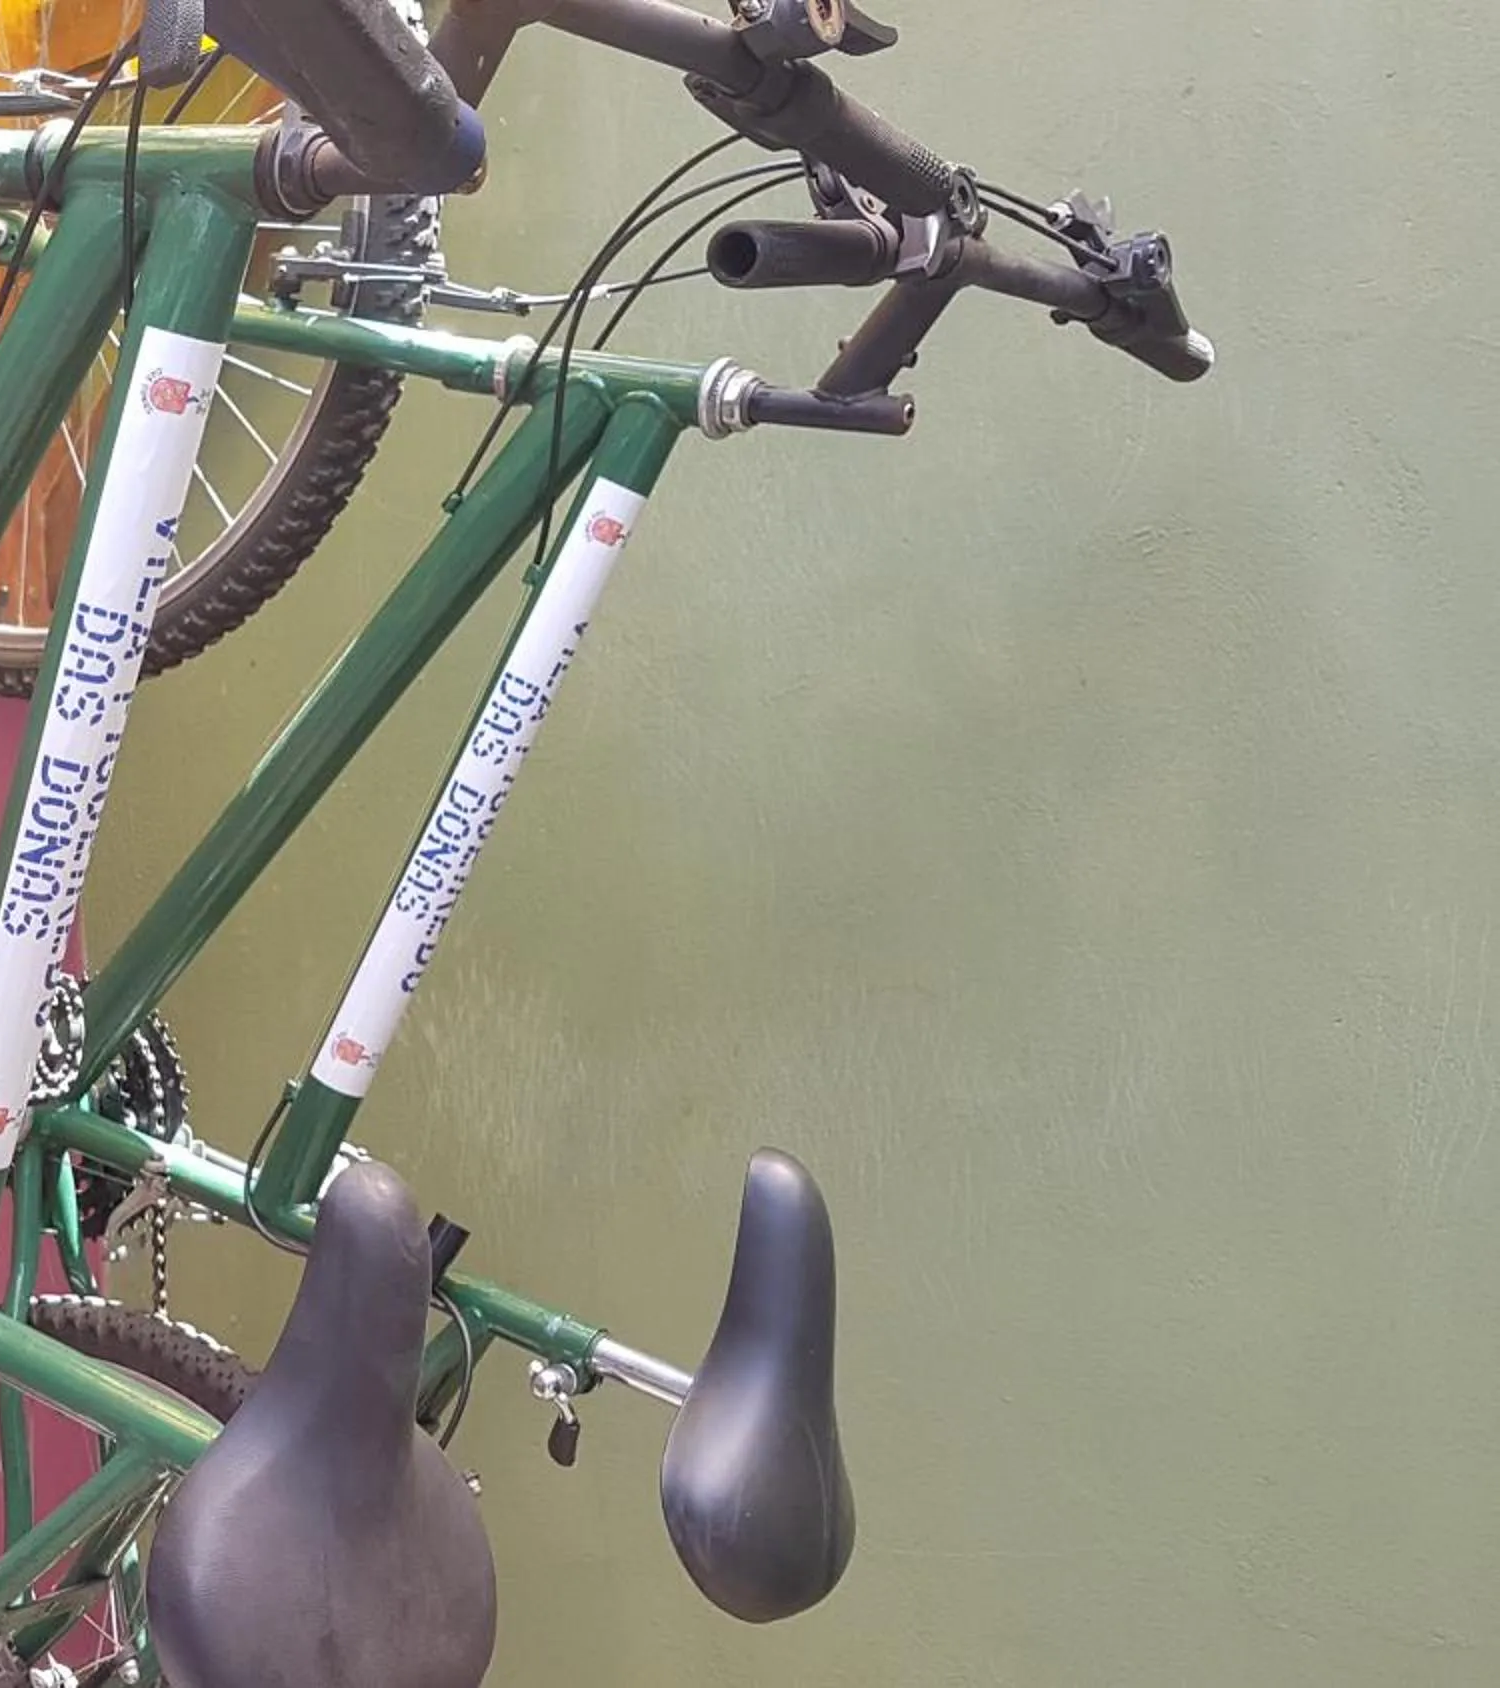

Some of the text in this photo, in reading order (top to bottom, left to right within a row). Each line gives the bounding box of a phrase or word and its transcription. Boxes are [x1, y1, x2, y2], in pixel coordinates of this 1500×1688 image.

[2, 602, 129, 940] DAS DONAS
[396, 672, 540, 920] DAS DONAS
